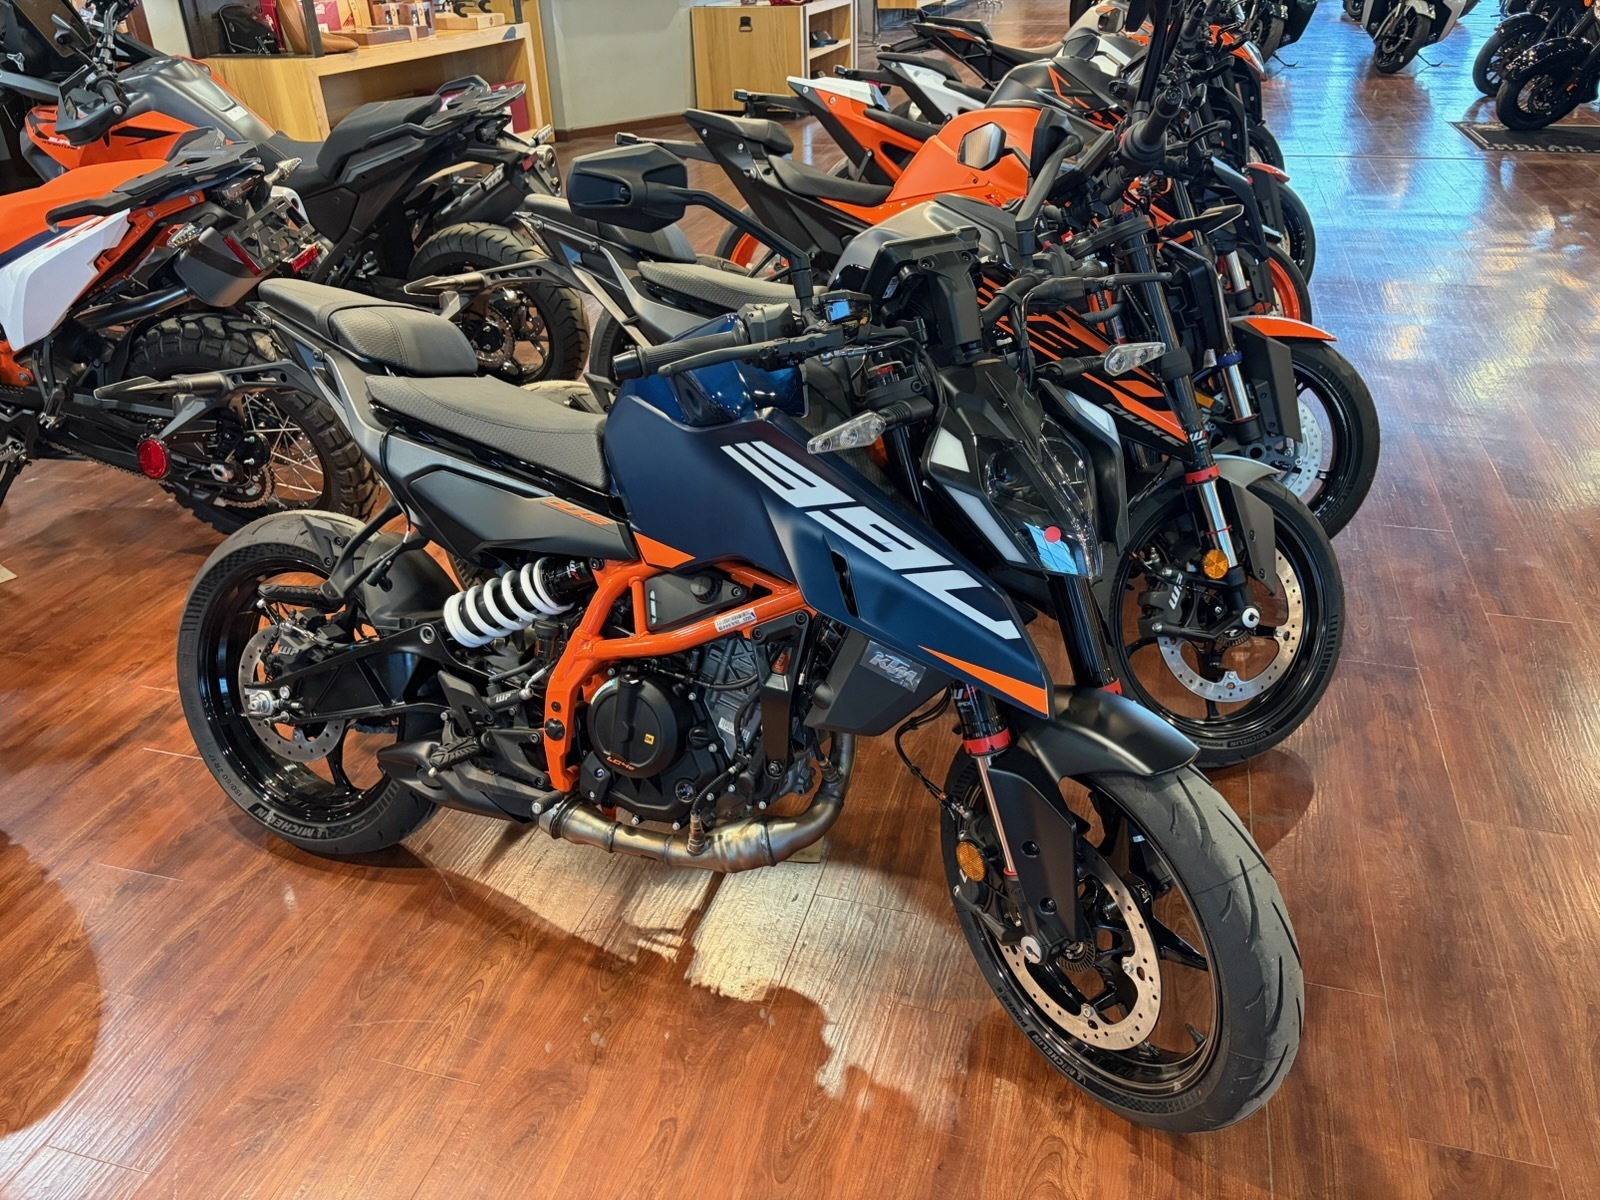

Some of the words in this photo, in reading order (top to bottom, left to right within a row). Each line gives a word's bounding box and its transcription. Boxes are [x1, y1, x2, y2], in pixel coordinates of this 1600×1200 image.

[1102, 403, 1185, 447] DUKE
[541, 499, 617, 526] DUKE
[277, 645, 299, 656] WP
[869, 652, 918, 685] KTM
[495, 692, 512, 703] WP
[213, 762, 225, 773] ZR
[221, 773, 244, 797] 150/60
[254, 806, 316, 837] MICHELIN
[1002, 994, 1029, 1029] POWER
[1031, 1033, 1077, 1077] MICHELIN
